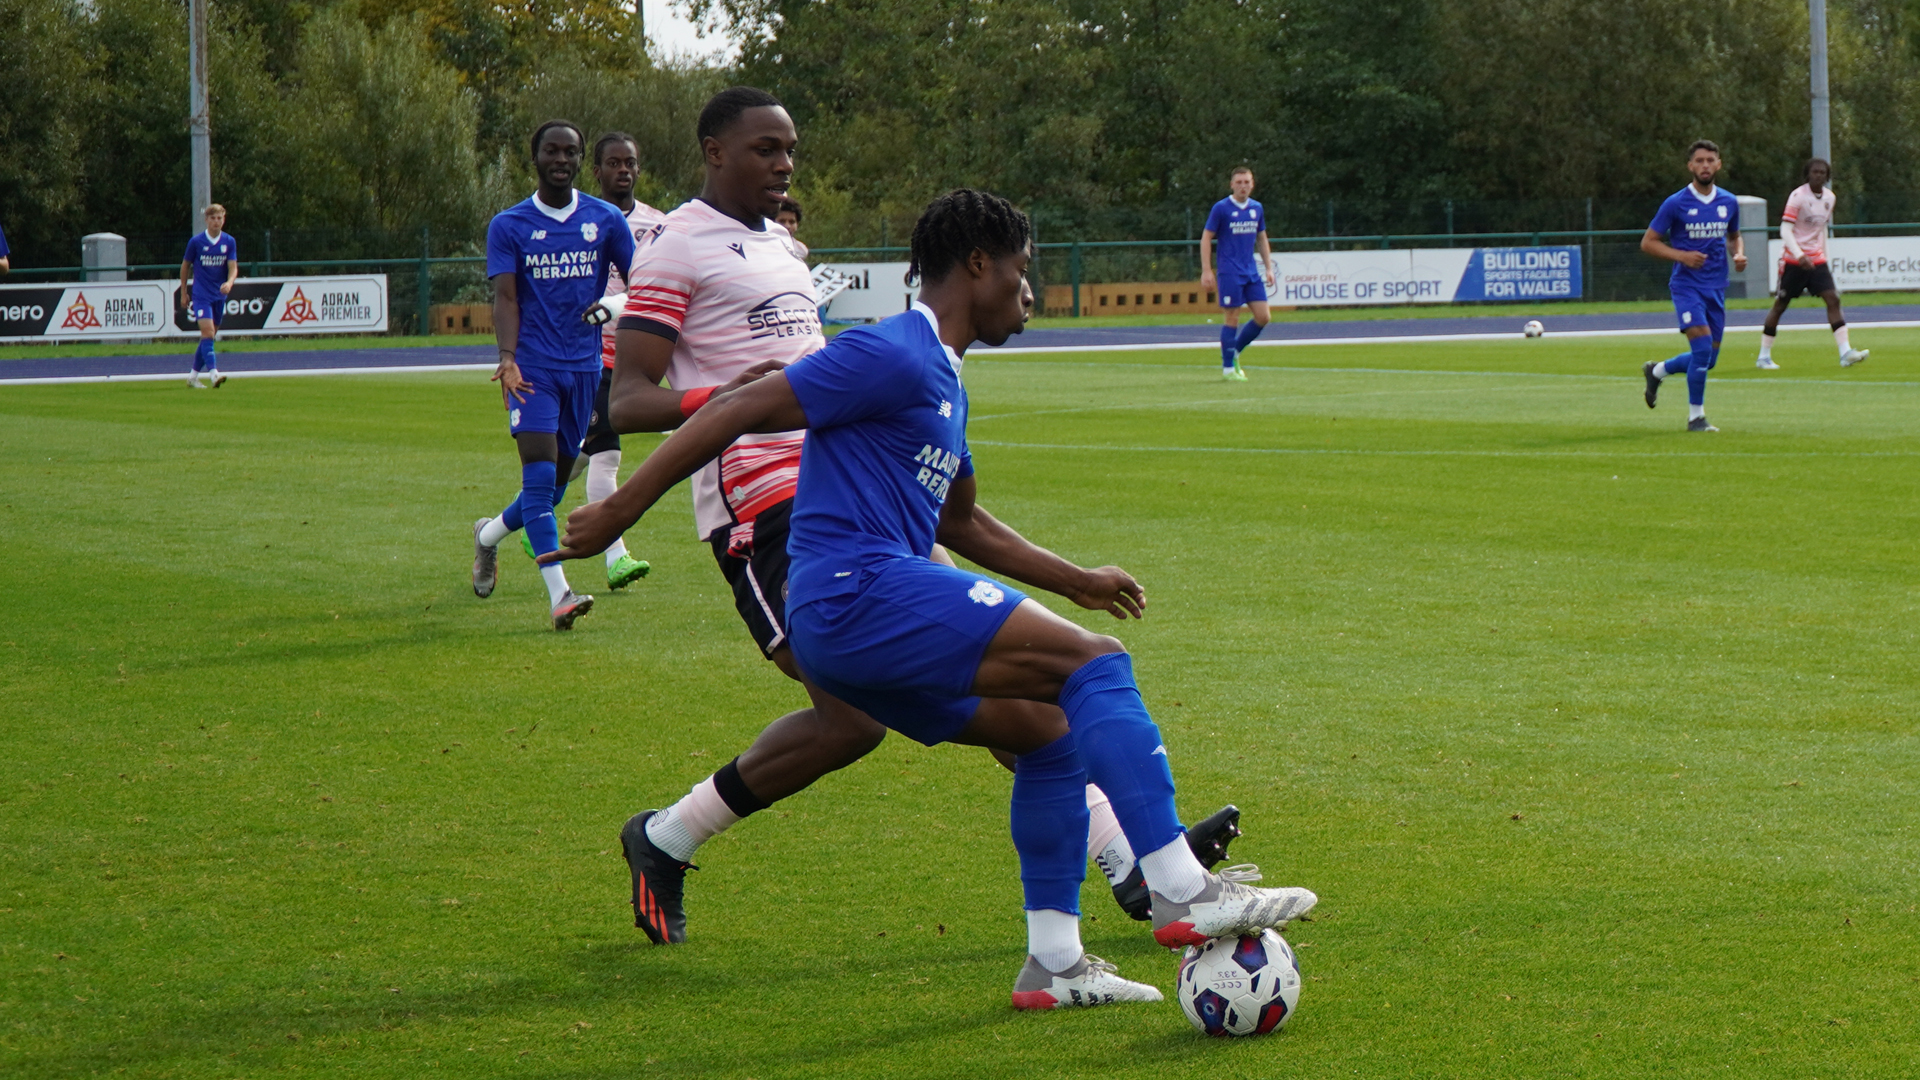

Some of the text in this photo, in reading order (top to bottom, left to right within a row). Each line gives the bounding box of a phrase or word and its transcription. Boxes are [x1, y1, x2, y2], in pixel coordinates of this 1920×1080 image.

[525, 250, 598, 267] MALAYSIA
[1483, 251, 1570, 271] BUILDING
[1831, 257, 1874, 274] Fleet
[532, 263, 594, 279] BERJAYA
[1285, 274, 1337, 283] CARDIFF CITY
[1484, 269, 1570, 282] SPORTS FACILITIES
[1285, 280, 1442, 300] HOUSE OF SPORT
[1484, 280, 1571, 298] FOR WALES
[104, 298, 143, 312] ADRAN
[321, 292, 359, 306] ADRAN
[104, 311, 154, 327] PREMIER
[321, 306, 371, 321] PREMIER
[776, 325, 822, 338] LEASI
